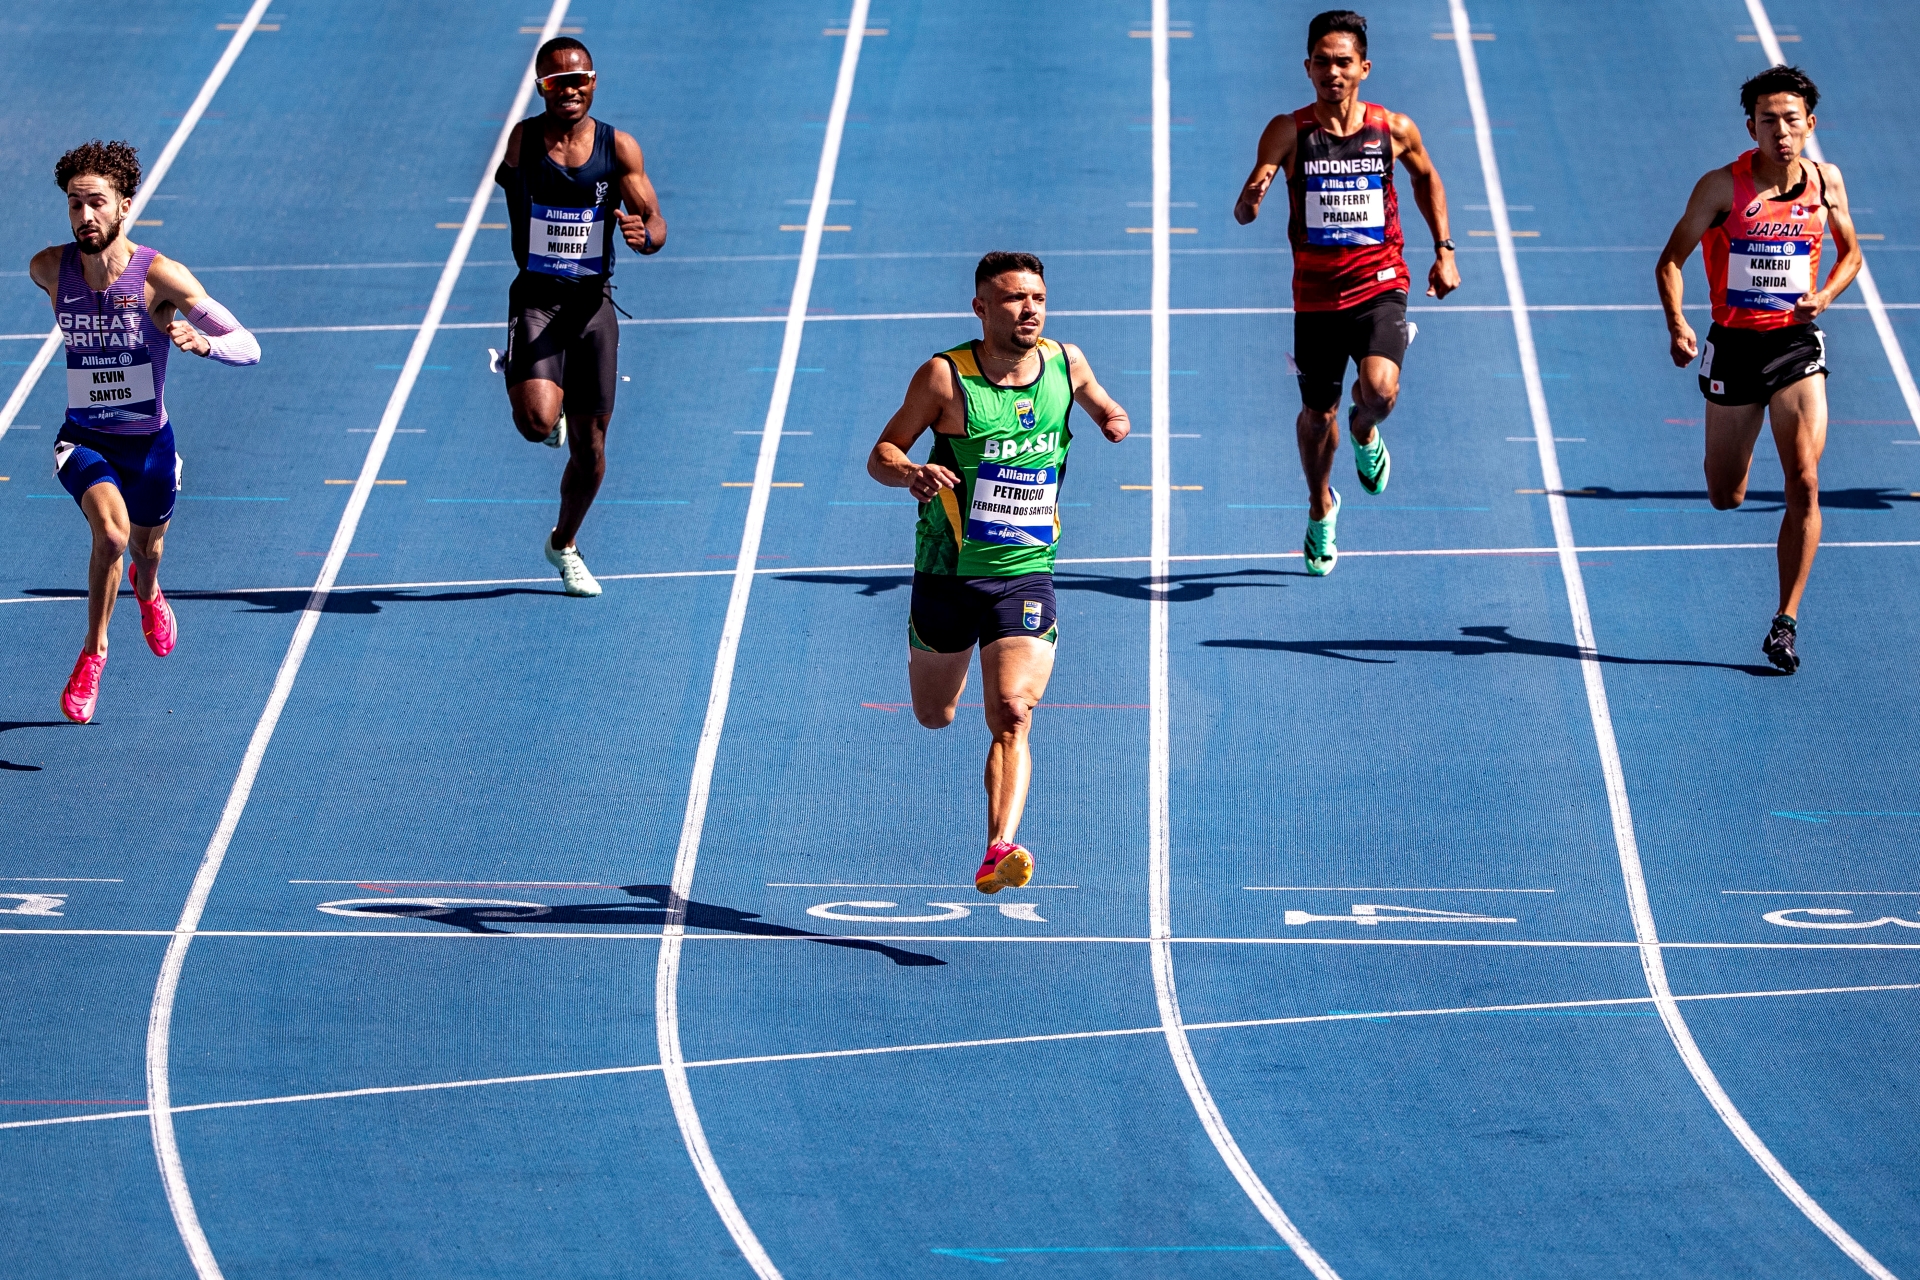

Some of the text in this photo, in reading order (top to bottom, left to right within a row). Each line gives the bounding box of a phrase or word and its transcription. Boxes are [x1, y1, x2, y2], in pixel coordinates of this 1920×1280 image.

[1304, 158, 1384, 175] INDONESIA
[1321, 179, 1355, 189] Allianz
[1319, 194, 1370, 206] NUR FERRY
[546, 209, 580, 220] Allianz
[1323, 211, 1368, 223] PRADANA
[546, 224, 590, 237] BRADLEY
[1746, 222, 1803, 237] JAPAN
[547, 241, 587, 254] MURERE
[1747, 243, 1782, 253] Allianz
[1750, 258, 1791, 271] KAKERU
[1752, 275, 1787, 287] ISHIDA
[59, 312, 139, 330] GREAT
[64, 331, 144, 347] BRITAIN
[81, 356, 117, 366] Allianz
[92, 370, 125, 384] KEVIN
[89, 387, 132, 402] SANTOS
[997, 468, 1036, 482] Allianz
[993, 485, 1044, 501] PETRUCIO
[972, 500, 1053, 516] FERREIRA DOS SANTOS
[806, 900, 1048, 922] 5
[1284, 904, 1517, 925] 4
